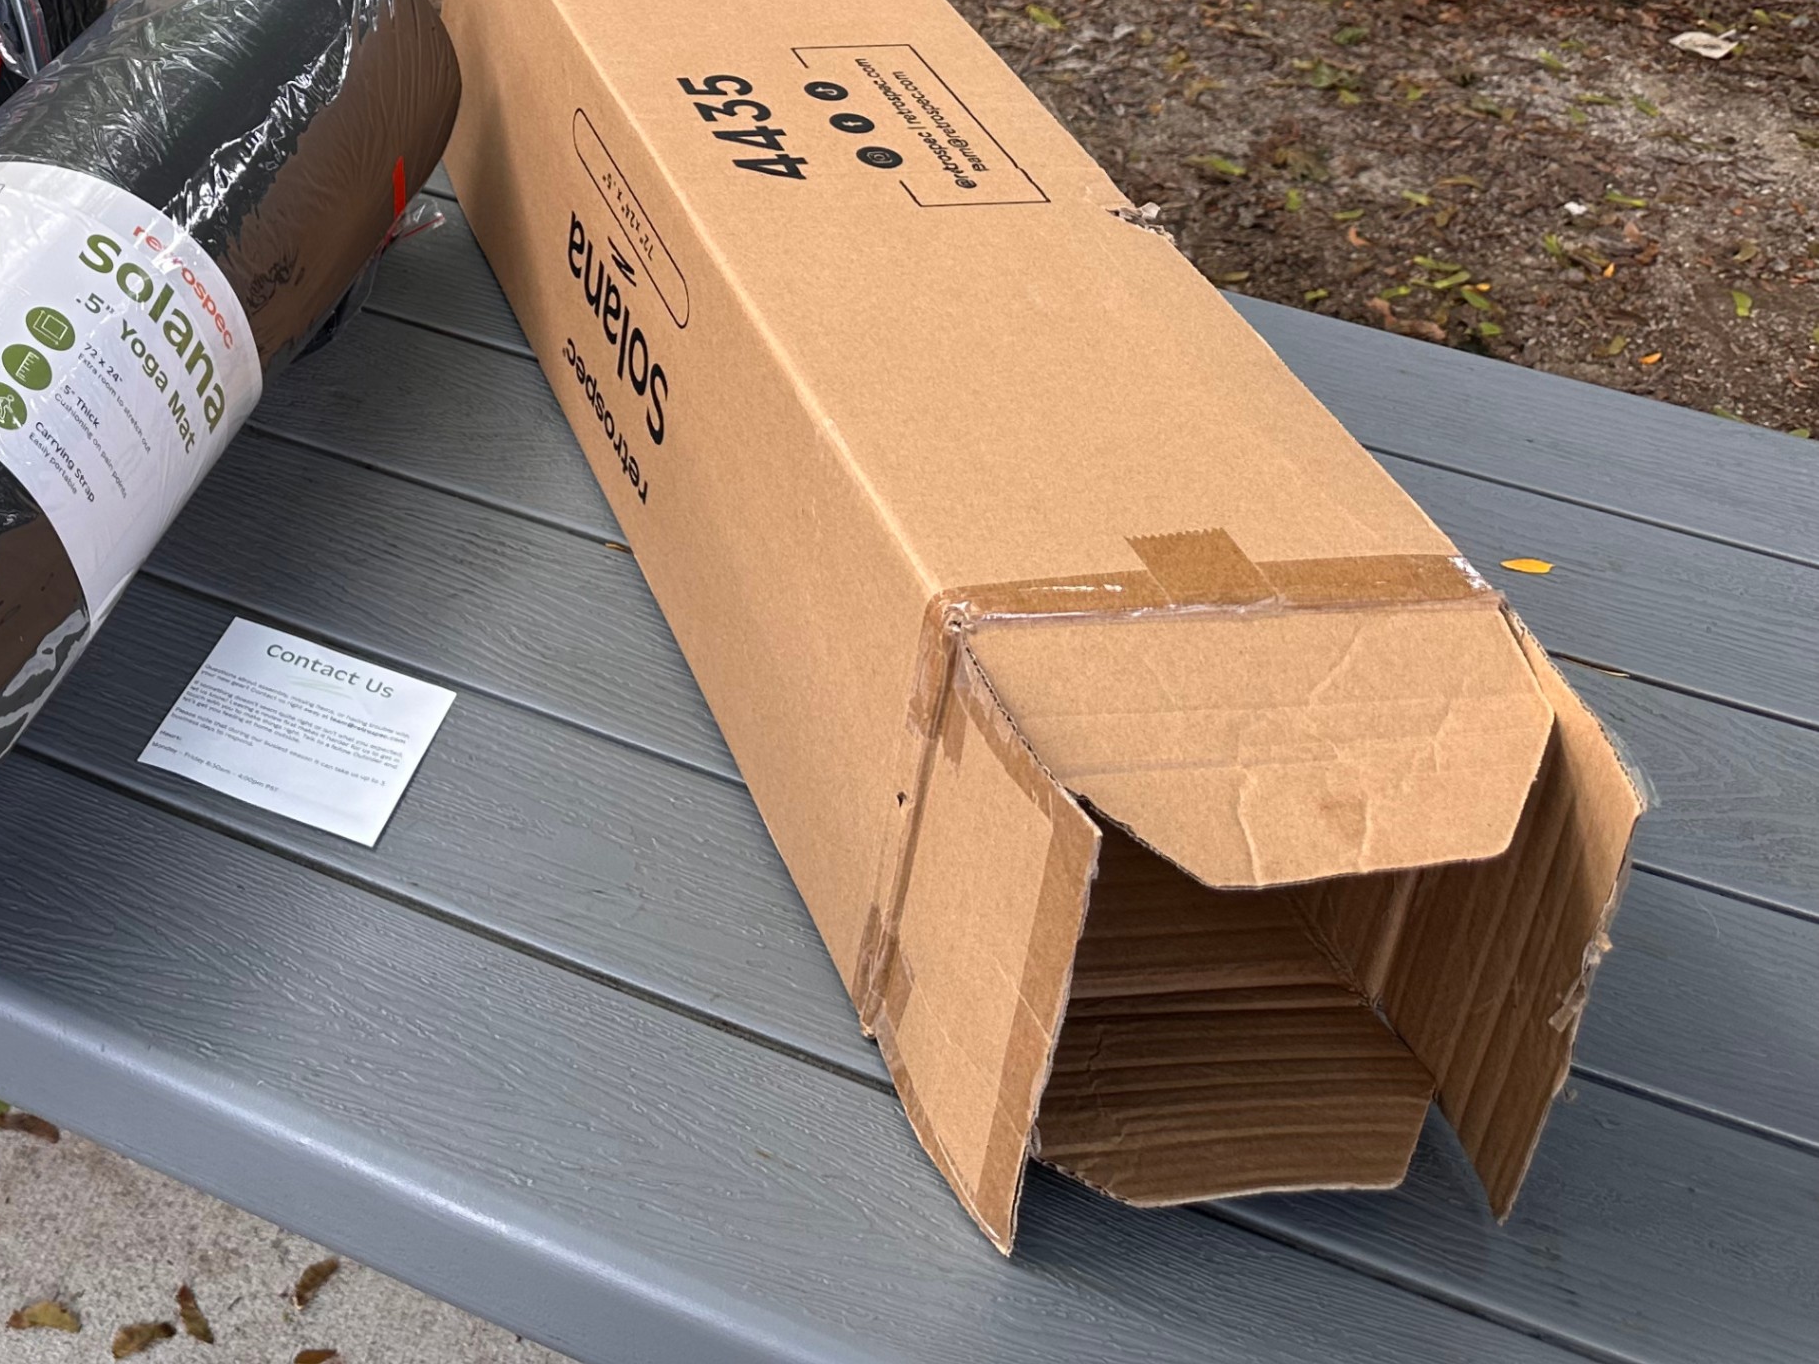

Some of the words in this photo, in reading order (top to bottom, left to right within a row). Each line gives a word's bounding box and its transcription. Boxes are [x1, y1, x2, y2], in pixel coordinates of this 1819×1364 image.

[677, 74, 809, 181] 4435
[855, 58, 921, 124] retrospec.com
[617, 188, 623, 202] x
[639, 234, 653, 262] 72"
[79, 234, 225, 434] Solana
[83, 342, 98, 358] 72
[99, 358, 106, 367] x
[567, 210, 668, 446] Solana
[75, 396, 101, 430] Thick
[77, 352, 98, 376] Extra
[98, 374, 121, 398] room
[115, 396, 125, 408] to
[123, 406, 144, 438] stretch
[141, 437, 151, 454] out
[120, 318, 168, 394] Yoga
[167, 390, 196, 454] Mat
[567, 338, 648, 505] retrospec
[29, 432, 51, 458] Easily
[49, 456, 79, 496] portable
[35, 421, 75, 470] Carrying
[74, 468, 95, 503] Strap
[55, 393, 93, 440] Cushioning
[92, 438, 102, 450] on
[100, 449, 114, 470] pain
[112, 468, 127, 499] points
[267, 644, 361, 686] Contact
[366, 678, 395, 699] Us
